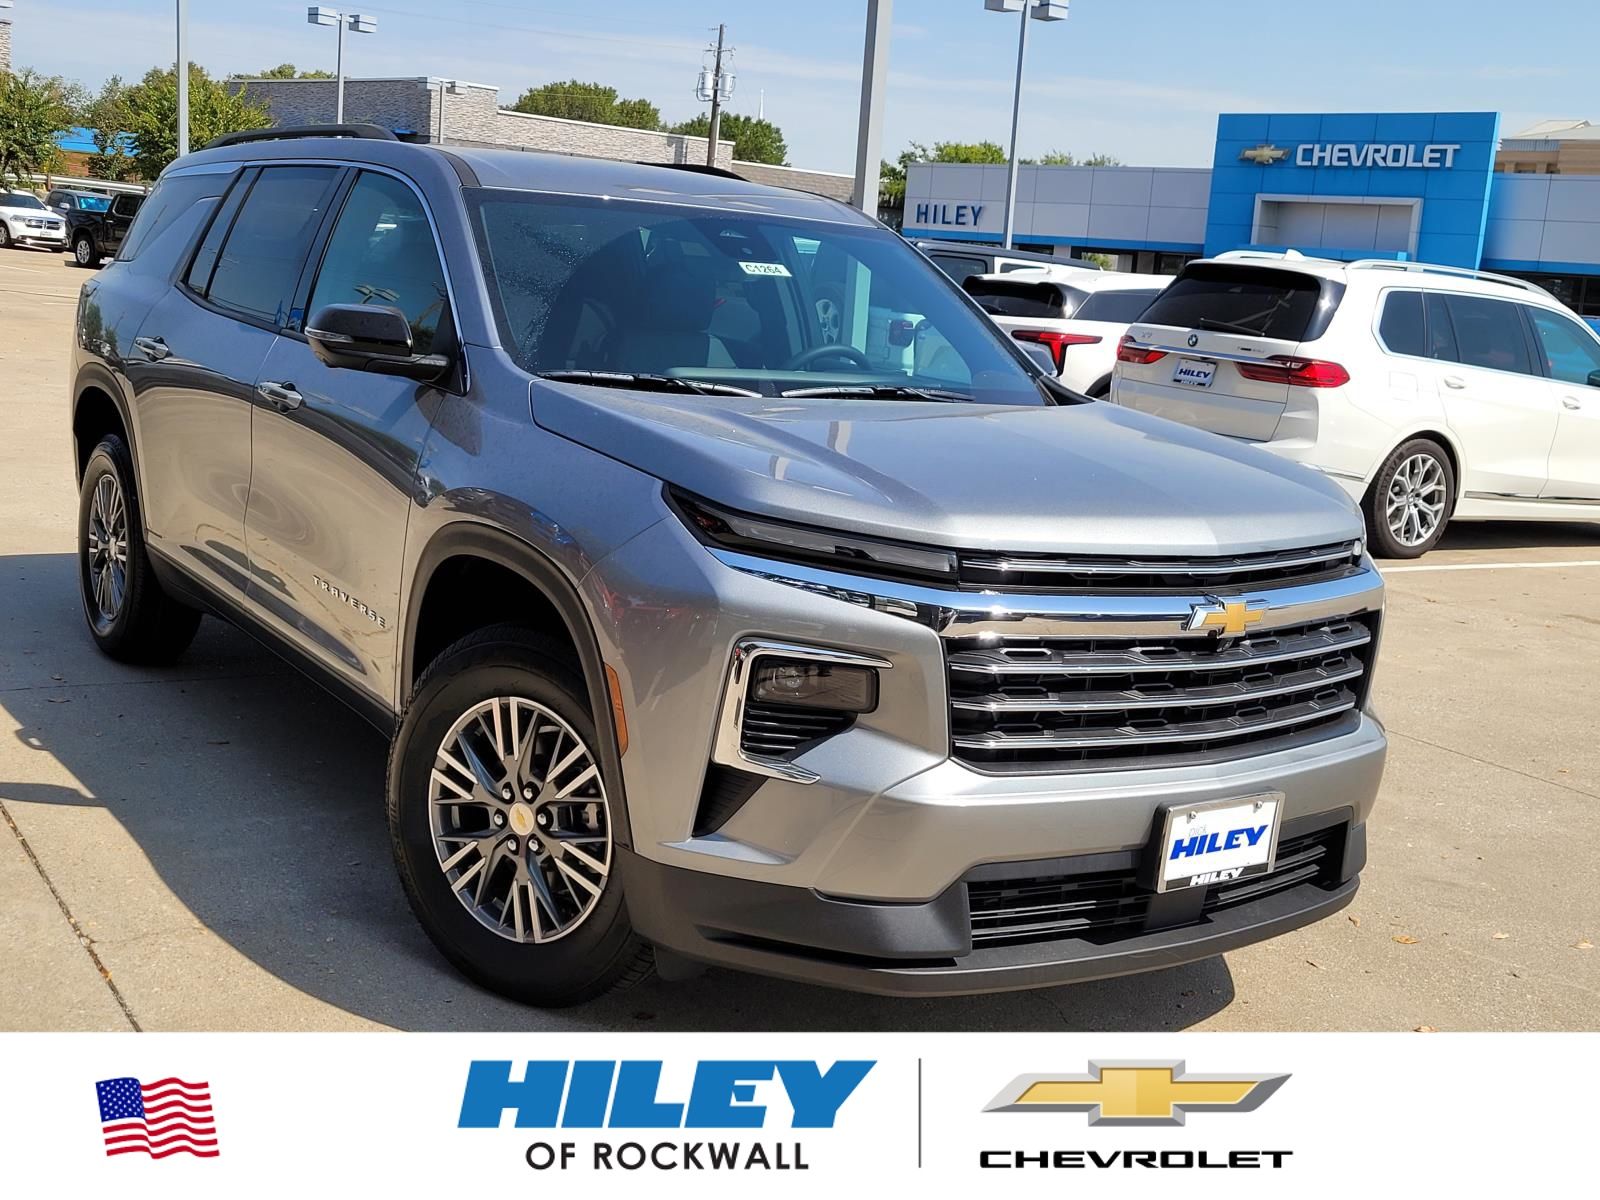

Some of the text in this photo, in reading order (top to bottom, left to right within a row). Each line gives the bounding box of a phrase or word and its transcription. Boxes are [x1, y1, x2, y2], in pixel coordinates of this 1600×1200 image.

[1296, 143, 1461, 168] CHEVROLET
[916, 203, 983, 227] HILEY
[745, 264, 782, 274] C1264
[1178, 368, 1211, 379] HILEY
[312, 574, 386, 629] TRAVERSE
[1169, 824, 1269, 860] HILEY
[1189, 867, 1244, 887] HILEY
